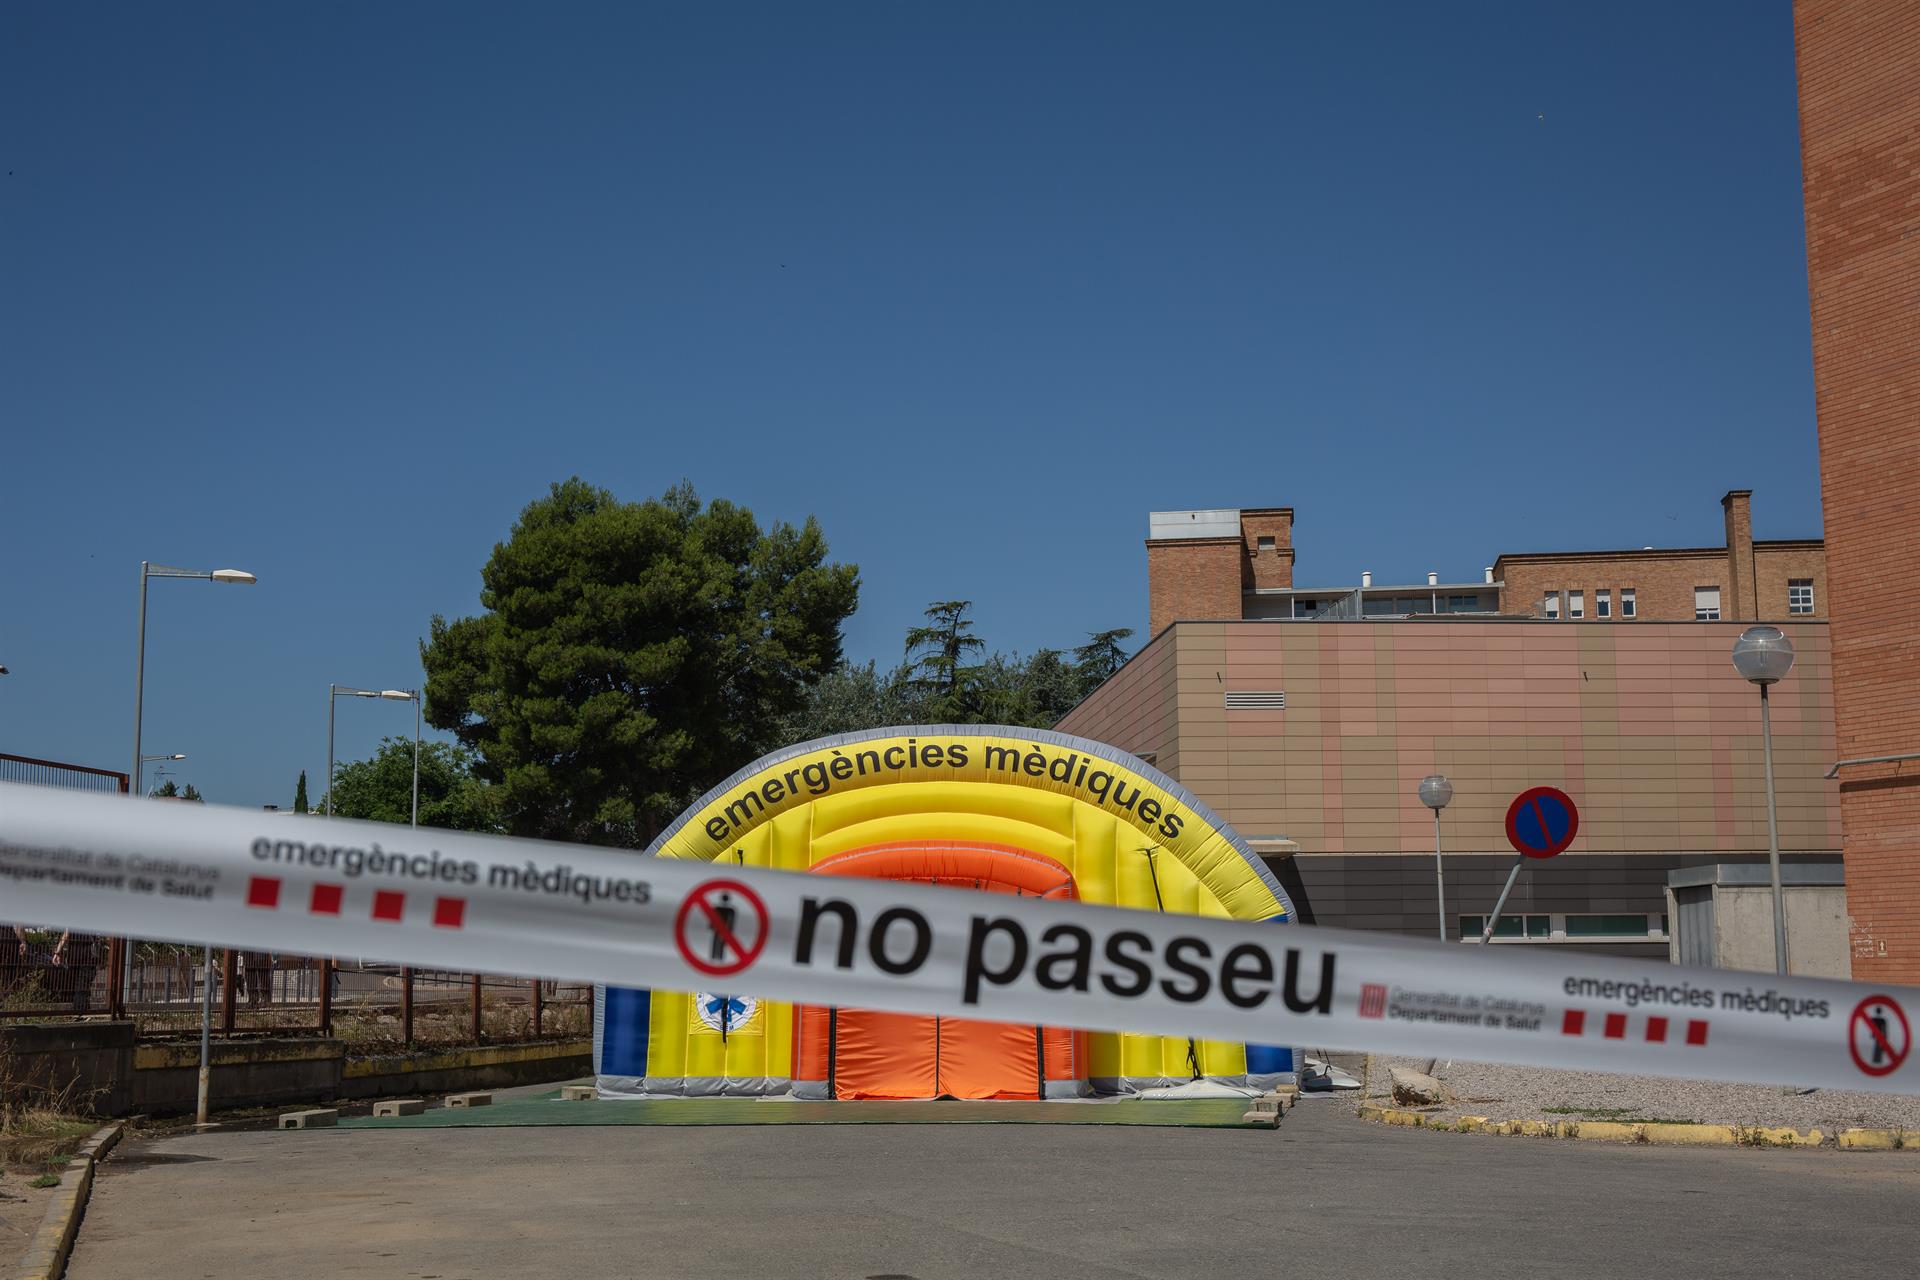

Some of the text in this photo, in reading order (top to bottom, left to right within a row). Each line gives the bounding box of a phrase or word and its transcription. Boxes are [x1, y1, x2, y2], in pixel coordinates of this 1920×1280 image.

[705, 739, 1184, 841] emergències mèdiques
[0, 863, 125, 892] epartament
[251, 836, 652, 904] emergències mèdiques
[794, 895, 1336, 1016] no passeu
[1388, 1003, 1542, 1032] Departament de Salut
[1563, 975, 1830, 1021] emergències mèdiques
